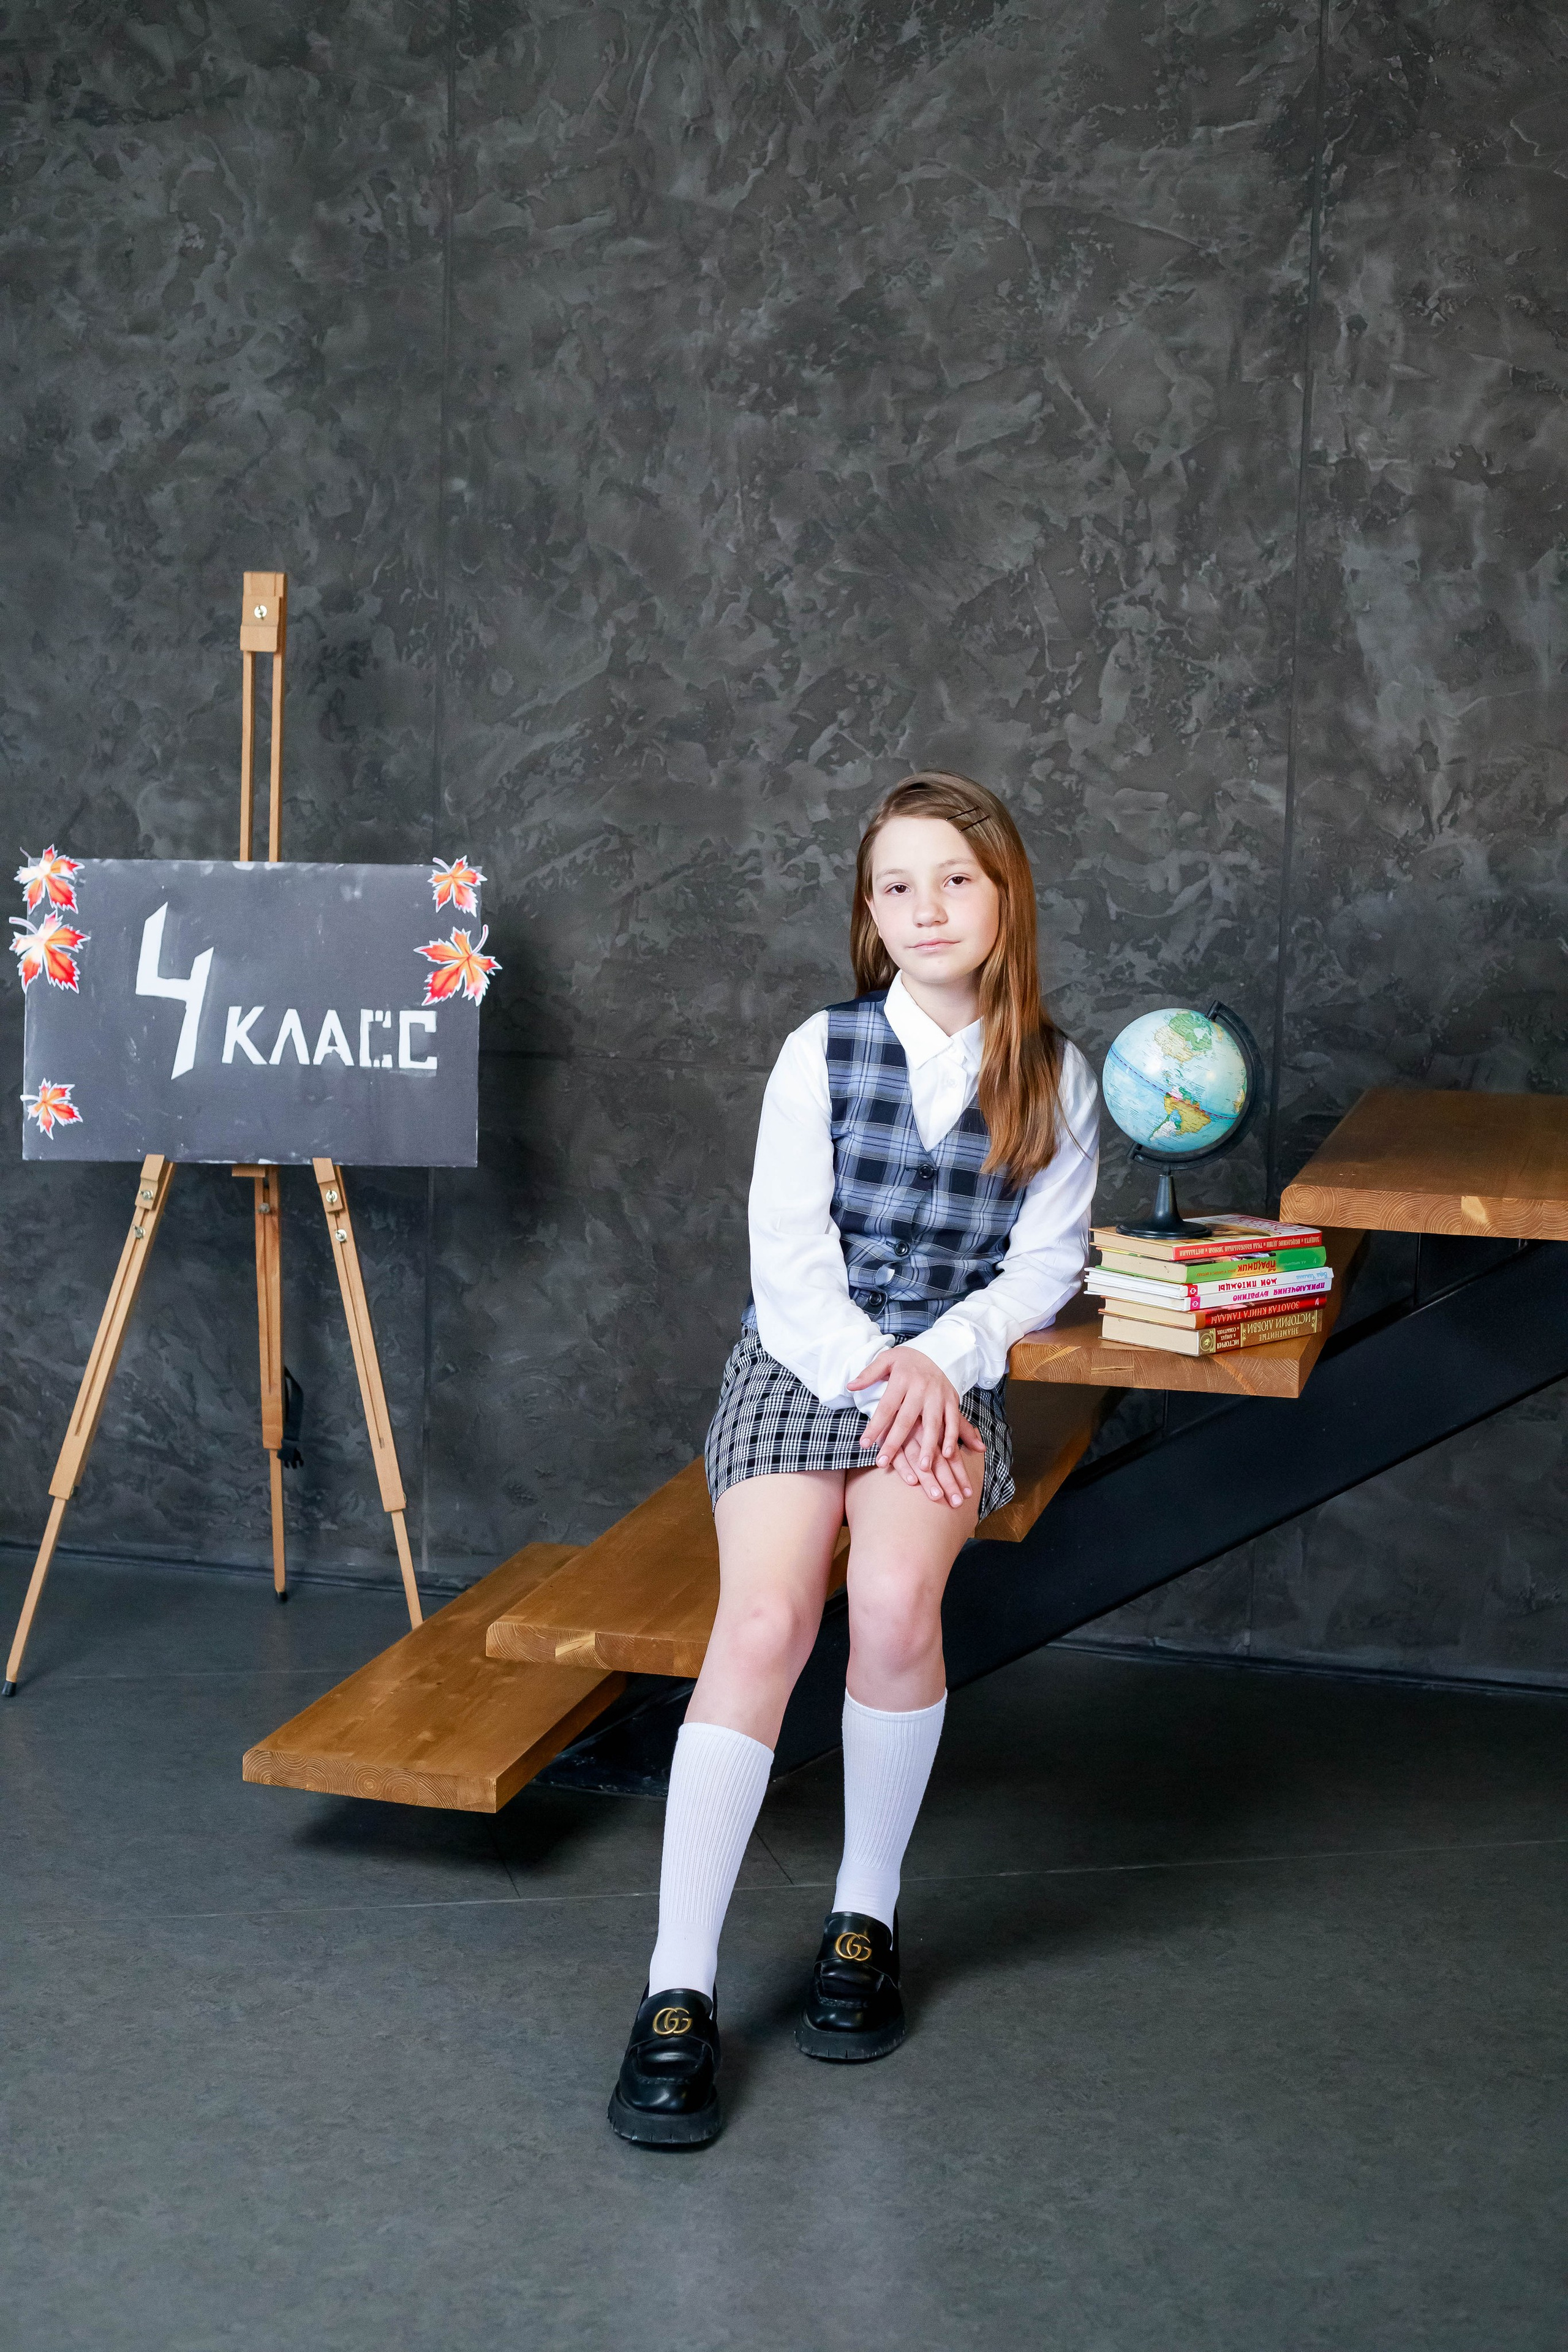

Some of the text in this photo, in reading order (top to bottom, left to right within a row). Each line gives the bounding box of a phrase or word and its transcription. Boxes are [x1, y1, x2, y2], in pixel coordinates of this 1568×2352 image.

[135, 901, 439, 1080] 4 КЛАСС
[1237, 1260, 1276, 1272] ПРАЗДНИК
[1218, 1278, 1278, 1292] МОИ ПИТОМЦЫ
[1273, 1282, 1325, 1296] ПРИКЛЮЧЕНИЯ
[1211, 1301, 1300, 1324] ЗОЛОТАЯ КНИГА ТАМАДЫ
[1247, 1313, 1311, 1334] ИСТОРИИ ЛЮБВИ
[1216, 1327, 1237, 1335] СОБЫТИЯХ
[1259, 1327, 1299, 1341] ЗНАМЕНИТЫЕ
[1216, 1339, 1239, 1349] ИСТОРИЯ
